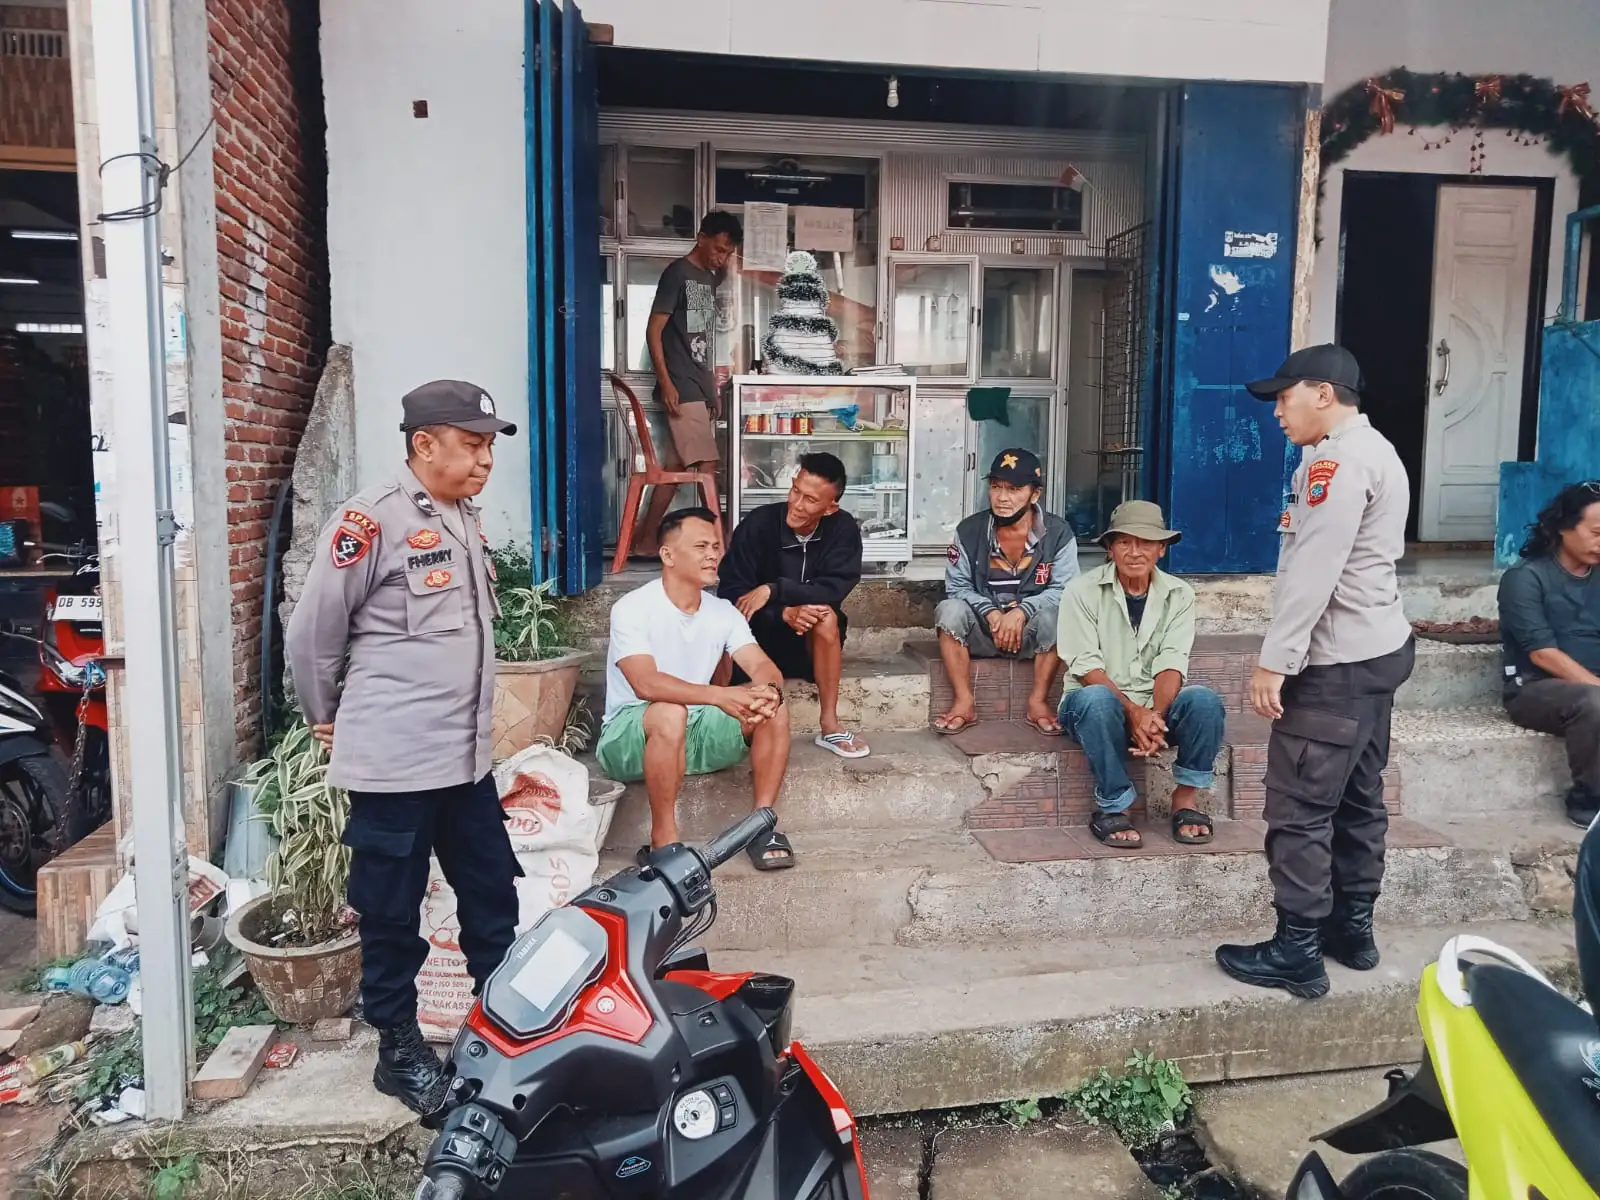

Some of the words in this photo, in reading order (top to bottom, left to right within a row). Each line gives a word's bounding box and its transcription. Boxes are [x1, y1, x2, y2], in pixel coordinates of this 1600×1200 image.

[348, 512, 376, 532] SPKT
[508, 816, 535, 832] DO
[425, 957, 460, 967] NETTO
